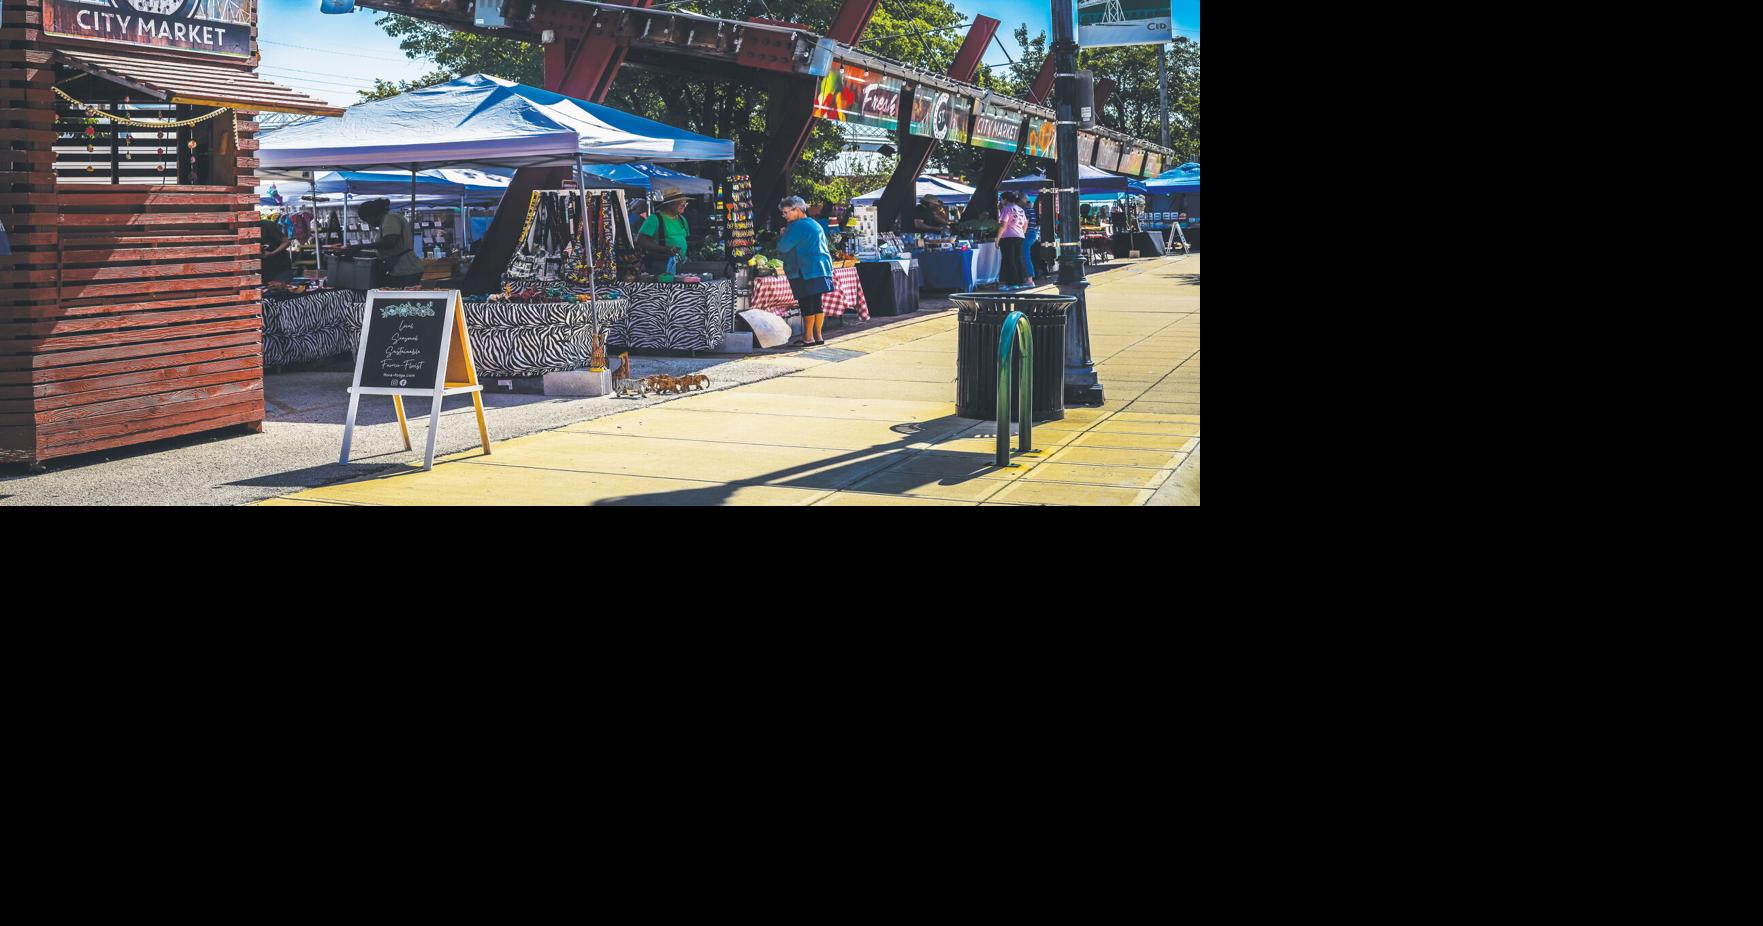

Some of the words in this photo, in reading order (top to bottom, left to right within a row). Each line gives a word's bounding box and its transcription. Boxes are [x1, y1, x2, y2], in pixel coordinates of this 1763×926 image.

[76, 9, 131, 34] CITY
[138, 17, 226, 46] MARKET
[861, 83, 898, 117] Fresh
[976, 117, 993, 136] CITY
[992, 120, 1019, 140] MARKET
[385, 345, 421, 358] Sustainable
